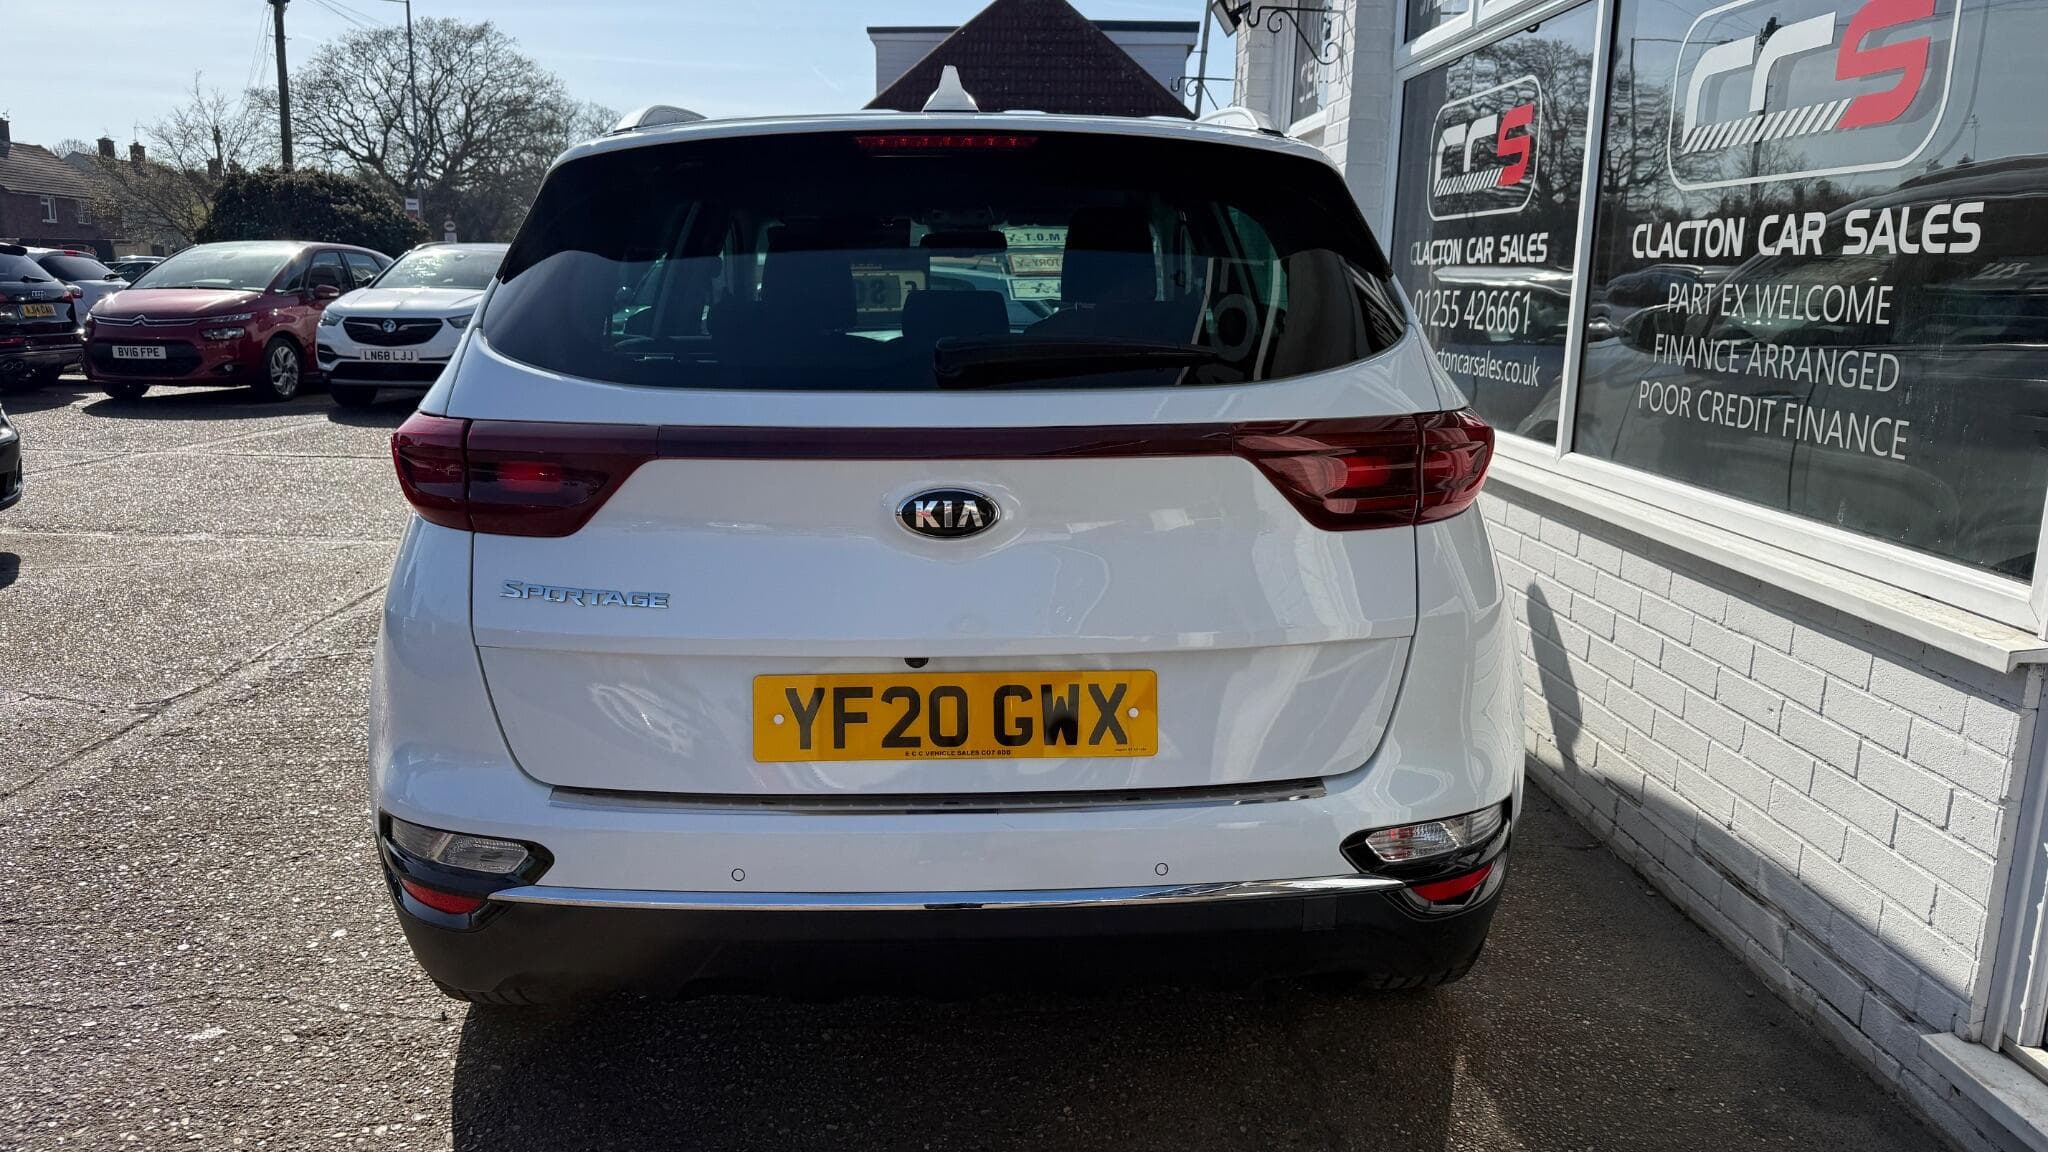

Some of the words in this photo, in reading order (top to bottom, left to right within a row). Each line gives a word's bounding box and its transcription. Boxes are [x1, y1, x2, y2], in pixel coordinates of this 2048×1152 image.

[1410, 238, 1463, 266] CLACTON
[1466, 235, 1495, 264] CAR
[1498, 232, 1549, 263] SALES
[1632, 216, 1746, 259] CLACTON
[1758, 212, 1827, 256] CAR
[1842, 202, 1985, 254] SALES
[1413, 289, 1461, 329] 01255
[1464, 290, 1531, 335] 426661
[1667, 282, 1716, 316] PART
[1721, 284, 1749, 318] EX
[1755, 284, 1893, 325] WELCOME
[117, 347, 139, 357] BV16
[140, 347, 160, 357] FPE
[364, 351, 390, 361] LN68
[393, 351, 414, 361] LJJ
[1653, 333, 1740, 373] FINANCE
[1746, 342, 1900, 392] ARRANGED
[1638, 380, 1692, 418] POOR
[1697, 389, 1777, 434] CREDIT
[1782, 402, 1910, 461] FINANCE
[914, 500, 984, 529] KIA
[499, 579, 672, 608] SPORTAGE
[784, 685, 969, 750] YF20
[993, 683, 1128, 747] GWX
